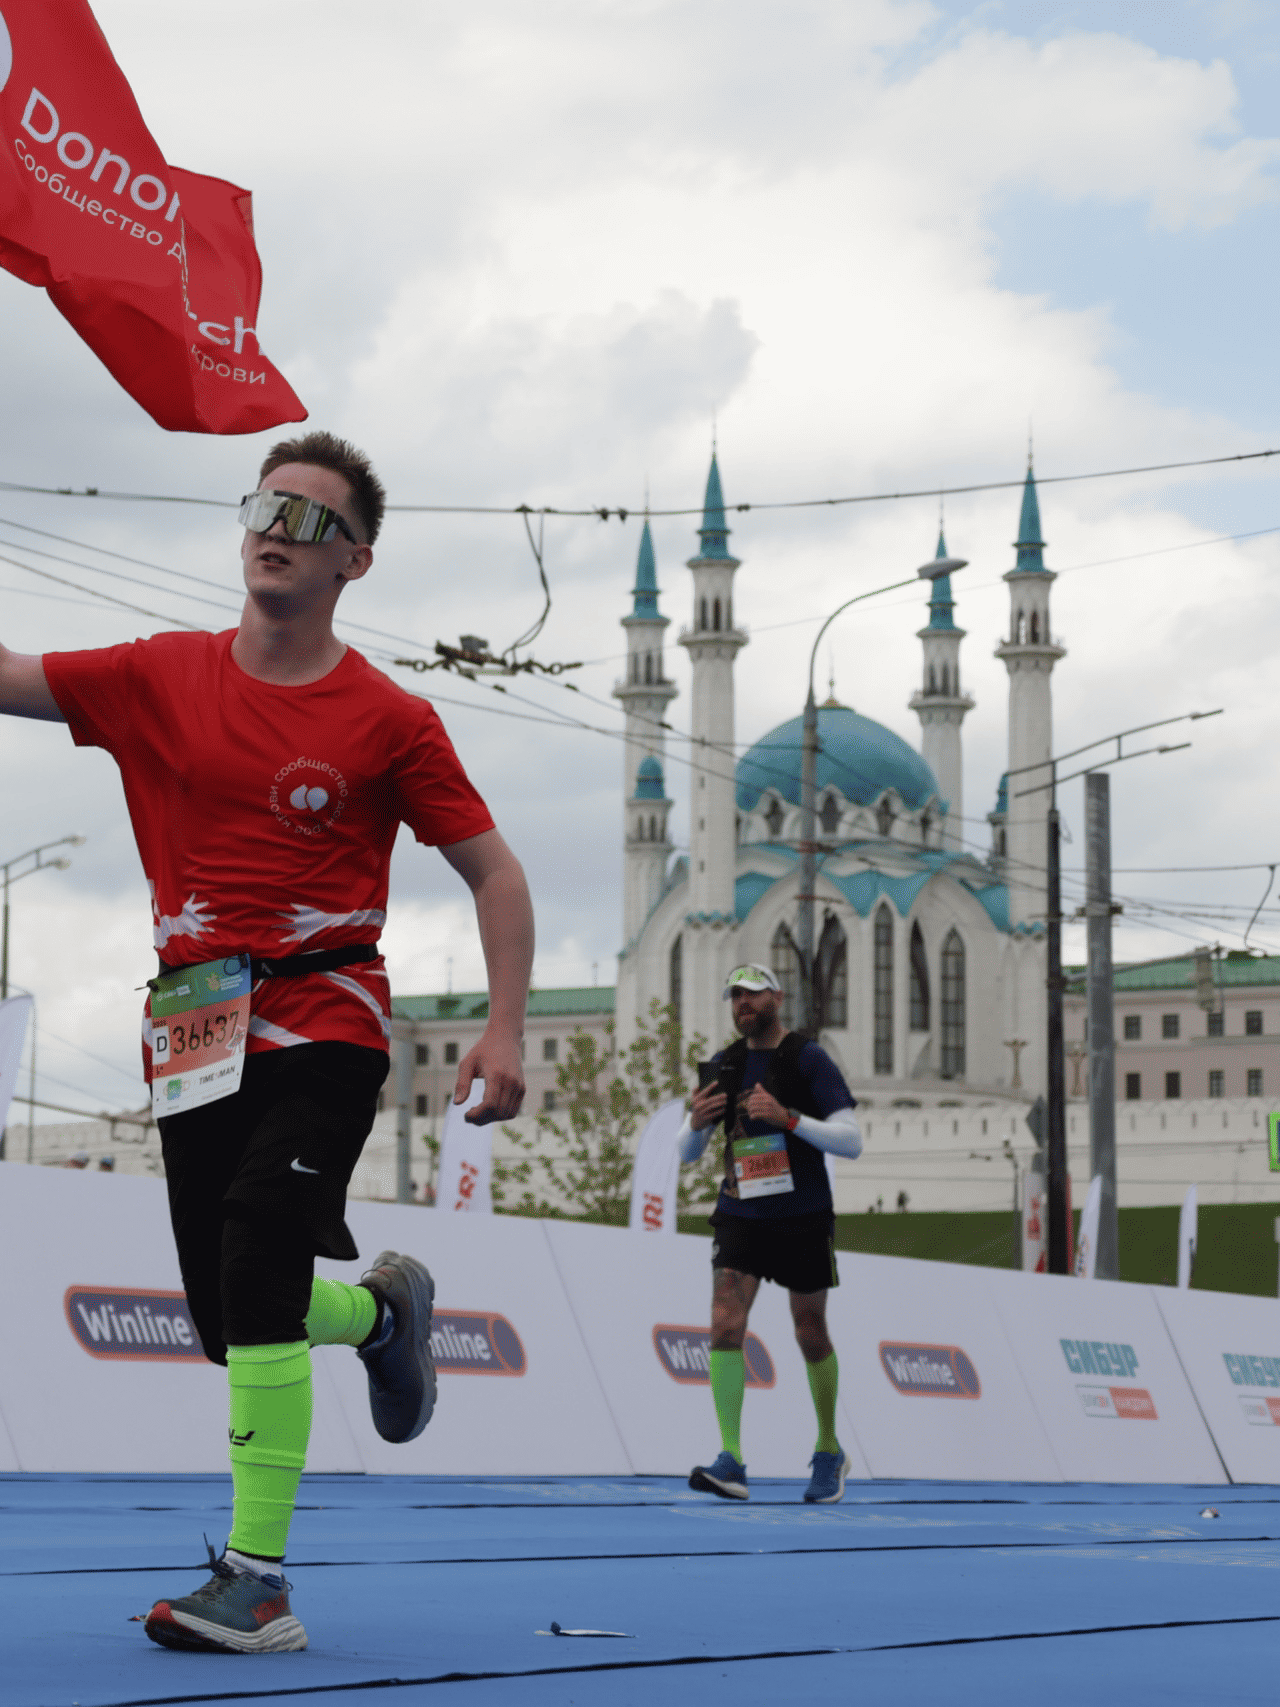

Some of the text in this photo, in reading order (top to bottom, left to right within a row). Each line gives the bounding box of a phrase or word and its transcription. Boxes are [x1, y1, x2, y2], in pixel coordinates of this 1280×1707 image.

[191, 343, 267, 385] крови
[157, 1035, 167, 1052] D
[173, 1011, 238, 1054] 36637
[77, 1303, 194, 1346] Winline
[885, 1354, 956, 1386] Winline
[1059, 1338, 1139, 1378] СИБУР
